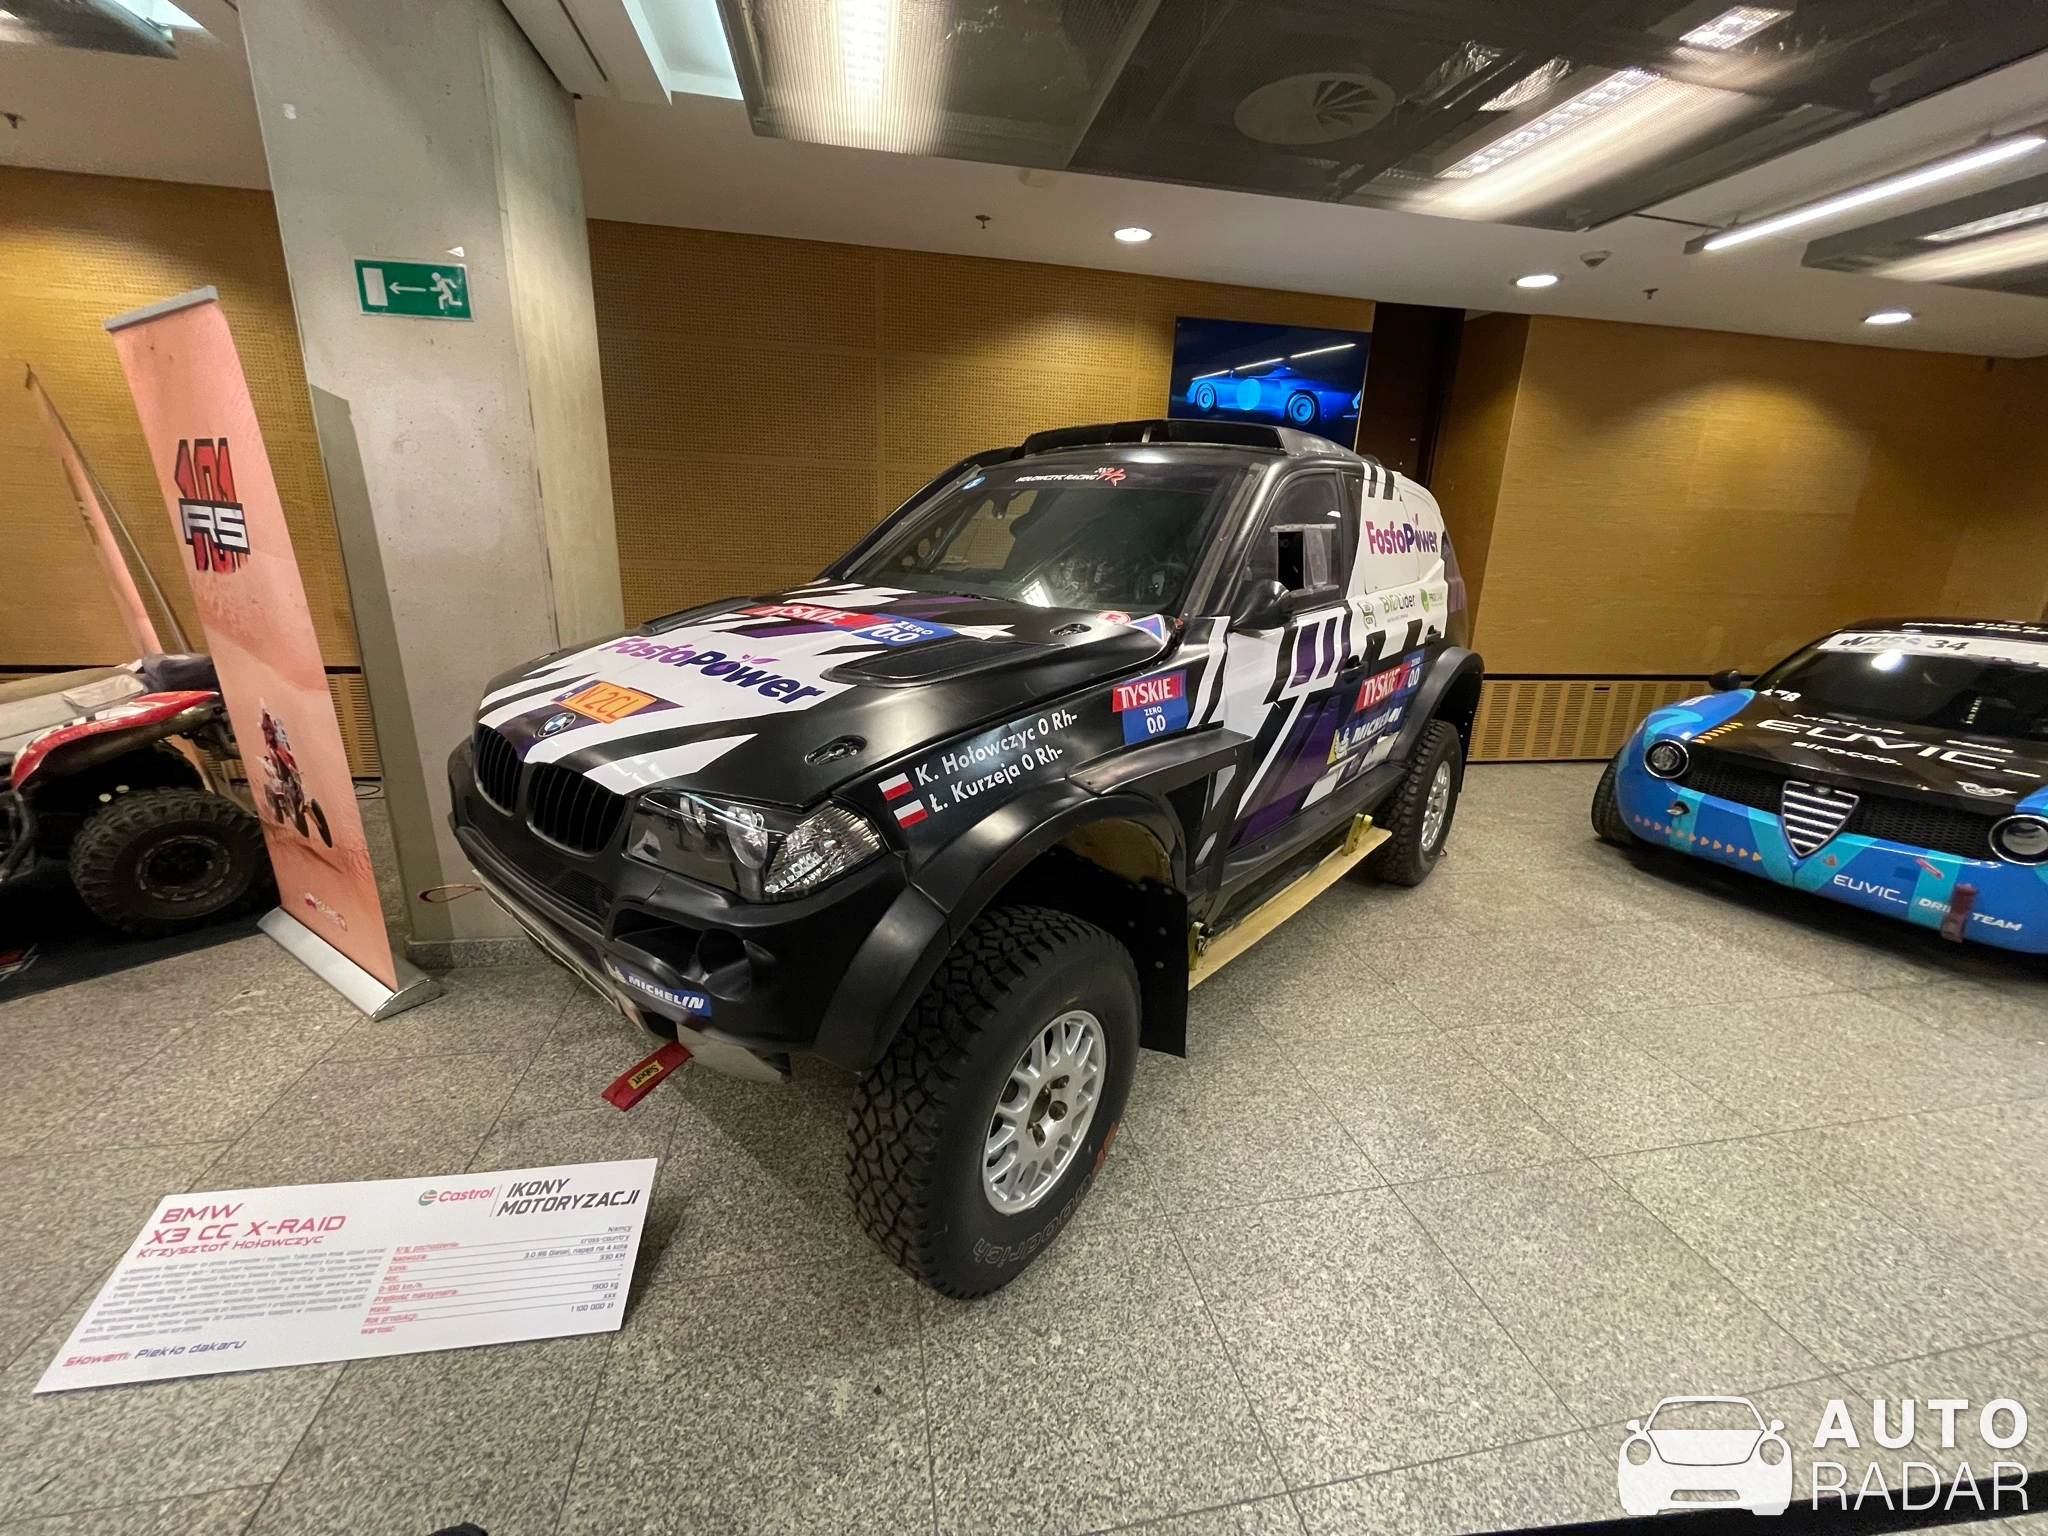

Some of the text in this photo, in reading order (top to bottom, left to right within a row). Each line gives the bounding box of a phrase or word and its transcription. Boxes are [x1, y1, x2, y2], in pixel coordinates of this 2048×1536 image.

[181, 503, 249, 549] RS
[1366, 516, 1438, 554] FosfoPower
[870, 627, 920, 642] 0.0
[896, 620, 935, 636] ZERO
[1926, 639, 1969, 651] 34
[602, 638, 826, 705] FosfoPower
[1117, 677, 1174, 709] TYSKIE
[1144, 705, 1163, 717] ZERO
[1146, 714, 1166, 734] 0.0
[915, 763, 940, 786] K.
[941, 727, 1036, 775] Hołowczyc
[1051, 708, 1078, 731] Rh-
[928, 792, 949, 813] Ł.
[950, 762, 1021, 803] Kurzeja
[1035, 743, 1063, 766] Rh-
[1972, 912, 2023, 931] TEAM
[628, 975, 704, 1009] MICHELIN
[438, 1187, 496, 1202] Castrol
[506, 1178, 571, 1198] IKONY
[160, 1202, 245, 1224] BMW
[497, 1189, 641, 1217] MOTORYZACJI
[144, 1215, 347, 1246] X3 CC X-RAID
[580, 1234, 630, 1243] cross-country
[136, 1235, 325, 1259] Krzysztof Hołowczyc
[610, 1281, 619, 1289] kg
[188, 1340, 247, 1354] dakaru
